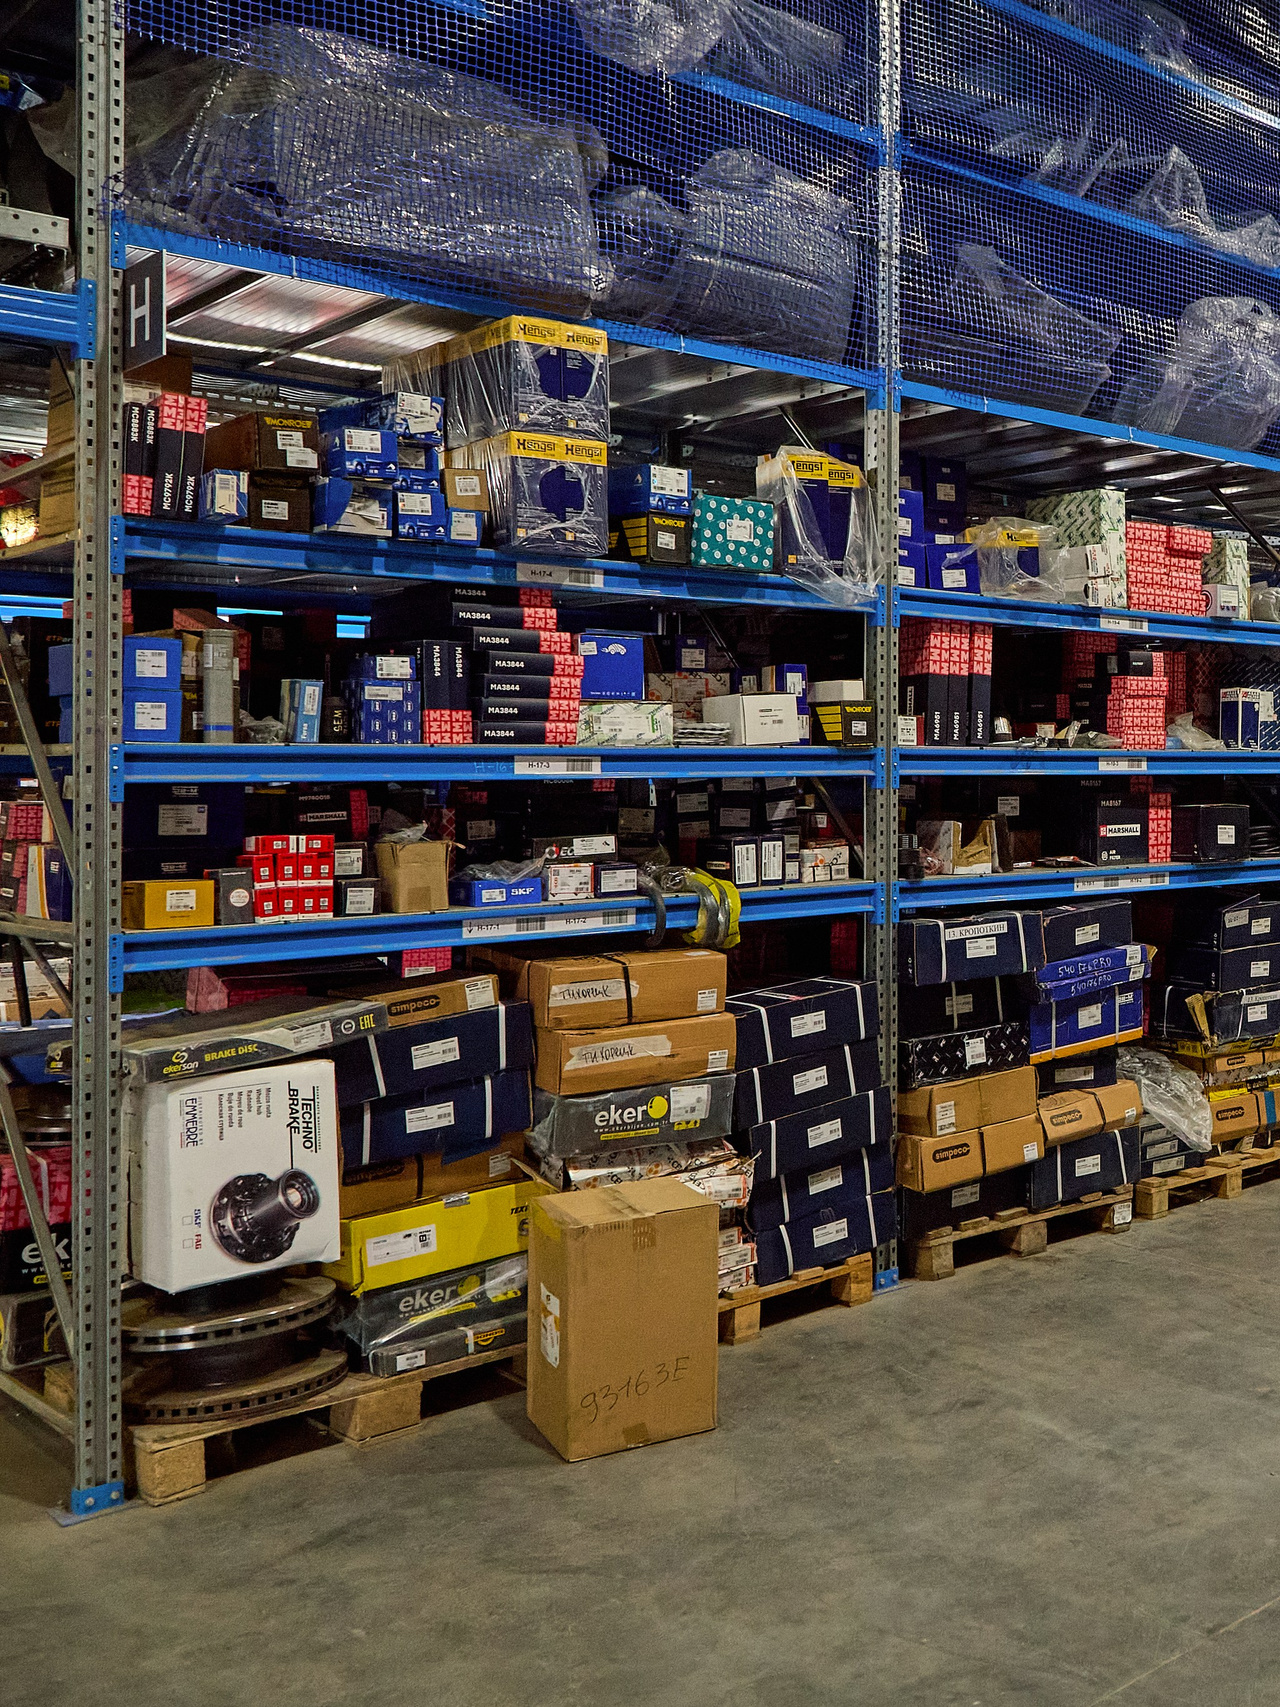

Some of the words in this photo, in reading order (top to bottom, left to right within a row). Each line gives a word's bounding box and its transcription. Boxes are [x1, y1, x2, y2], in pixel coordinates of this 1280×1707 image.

[129, 276, 151, 348] H
[265, 416, 312, 429] MONROE
[162, 472, 174, 511] MC9792K
[184, 475, 196, 513] MC9792K
[455, 588, 487, 597] MA3844
[458, 611, 491, 620] MA3844
[479, 636, 510, 645] MA3844
[433, 645, 441, 677] MA3844
[455, 646, 464, 678] MA3844
[495, 660, 525, 668] MA3844
[490, 683, 520, 692] MA3844
[487, 706, 518, 714] MA3844
[334, 709, 344, 732] SEM
[484, 730, 515, 738] MA3844
[308, 812, 346, 822] MARSHALL
[1107, 825, 1140, 835] MARSHALL
[511, 887, 535, 896] SKF
[958, 923, 1006, 937] КРОПОТКИН
[390, 998, 438, 1014] simpeco
[205, 1048, 237, 1062] BRAKE
[237, 1044, 259, 1055] DISC
[288, 1088, 300, 1135] BRAKE
[594, 1103, 649, 1127] eker
[184, 1097, 199, 1148] EMMERRE
[301, 1095, 315, 1150] TECHNO
[935, 1146, 970, 1161] simpeco
[194, 1208, 202, 1228] SKF
[398, 1284, 457, 1316] eker
